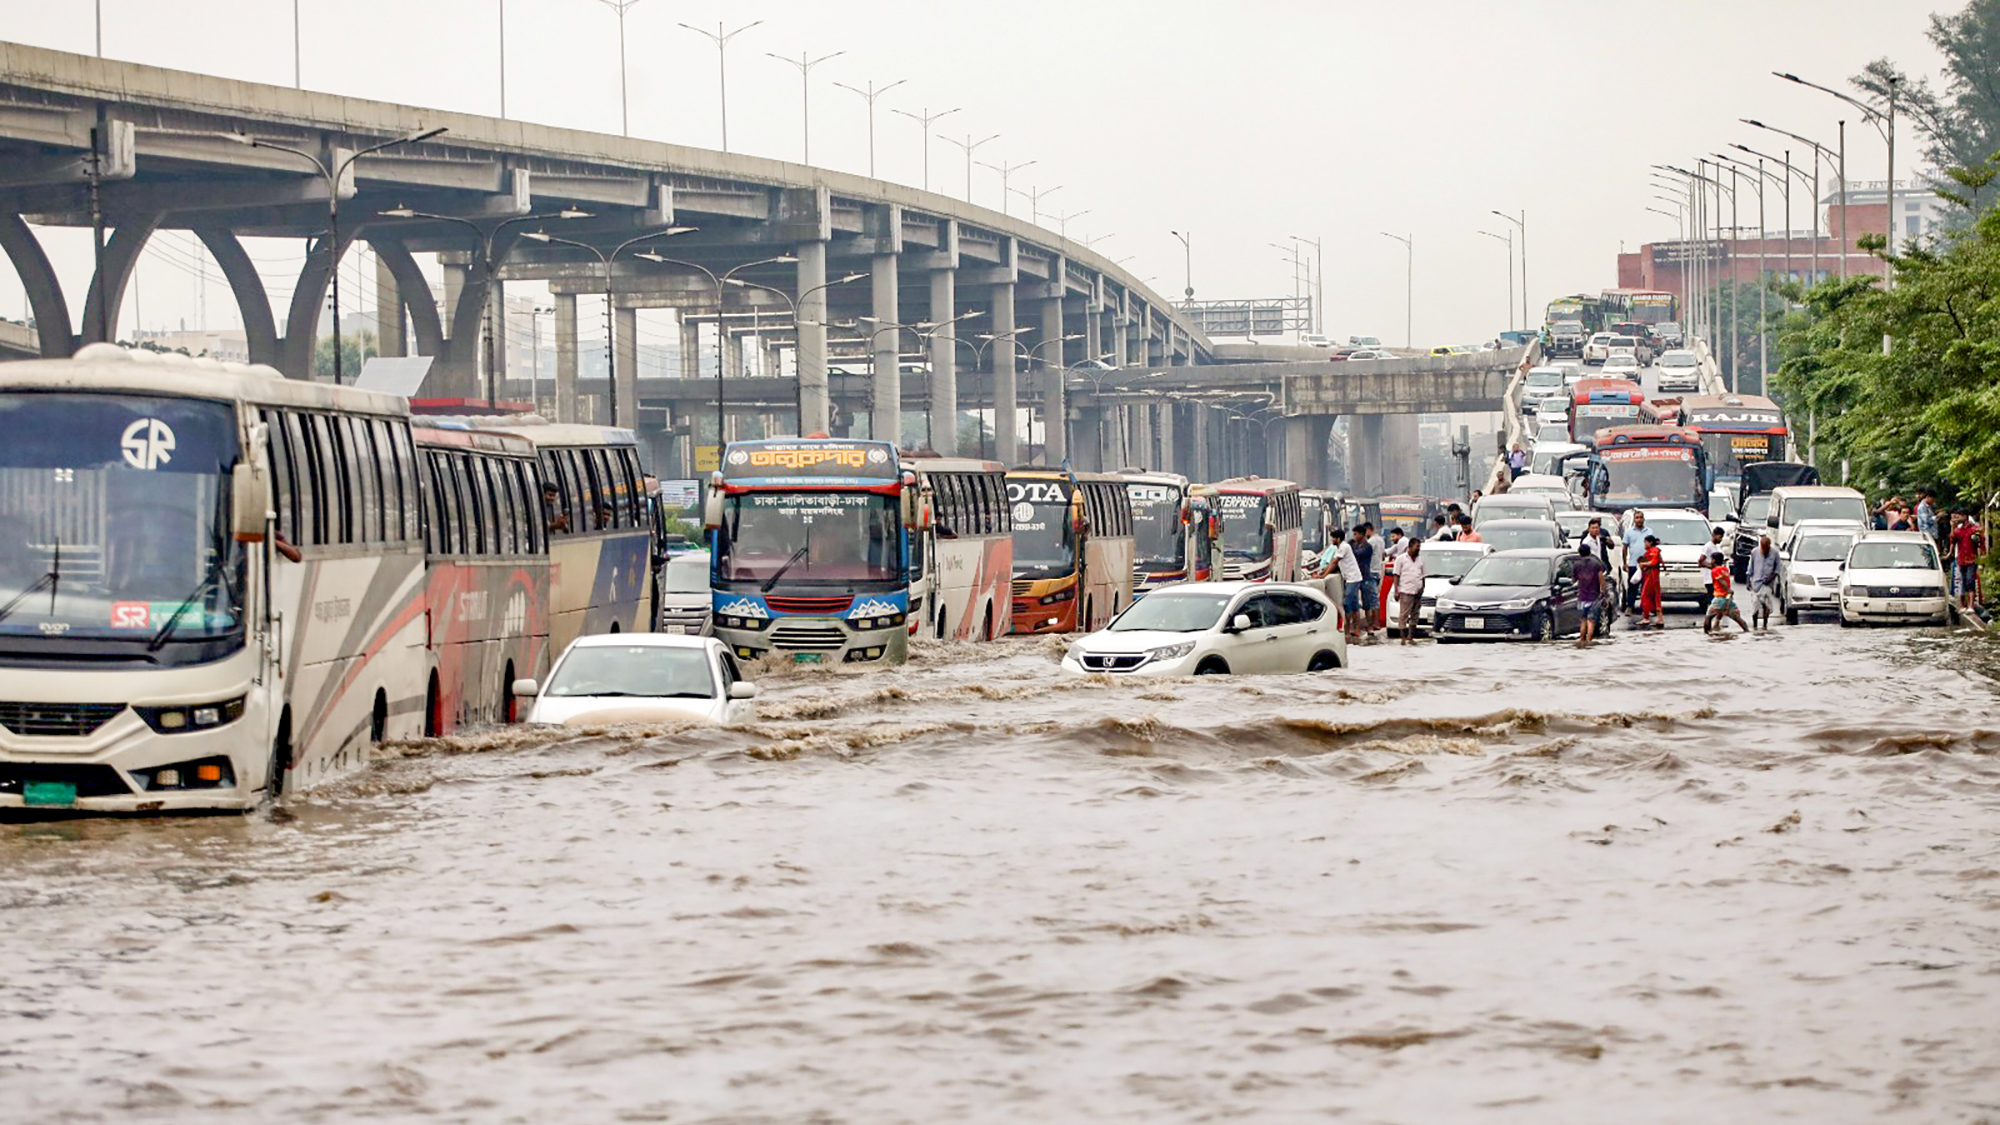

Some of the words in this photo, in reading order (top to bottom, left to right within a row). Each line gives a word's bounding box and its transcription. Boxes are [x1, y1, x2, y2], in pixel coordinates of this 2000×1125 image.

[1692, 413, 1779, 423] RAJIB
[121, 418, 176, 470] SR
[751, 450, 866, 468] তালুকদার
[115, 606, 148, 628] SR
